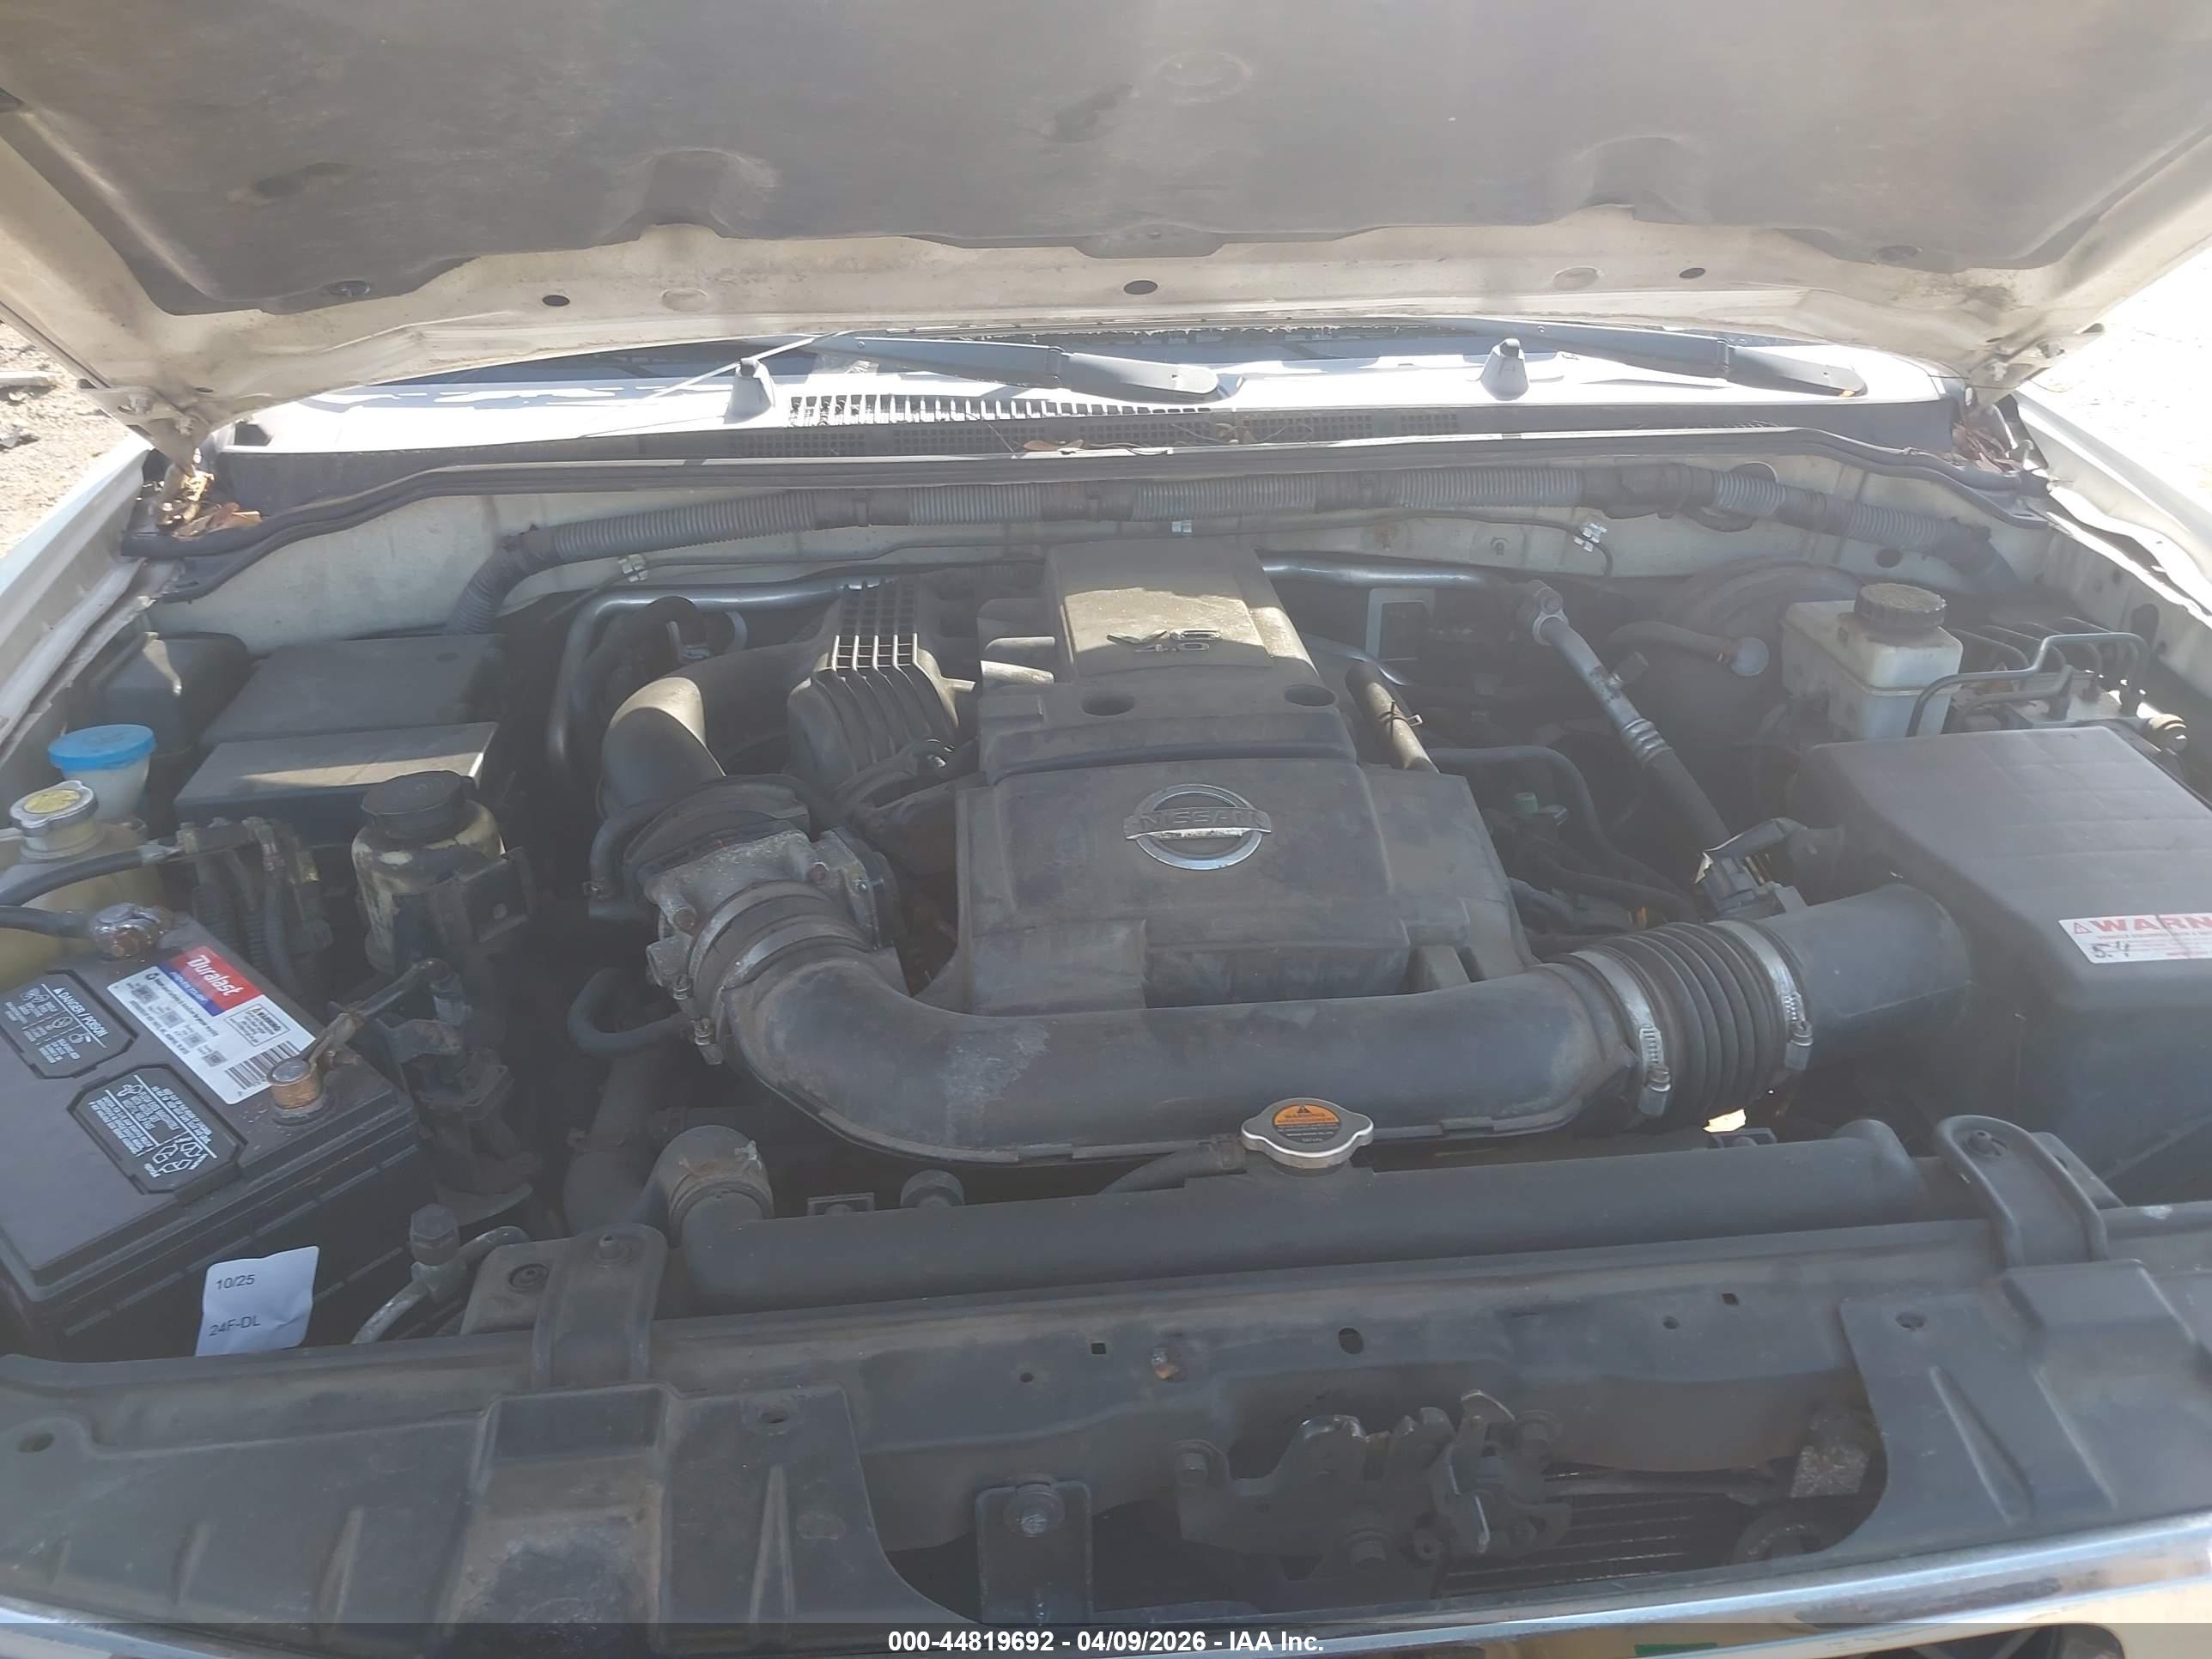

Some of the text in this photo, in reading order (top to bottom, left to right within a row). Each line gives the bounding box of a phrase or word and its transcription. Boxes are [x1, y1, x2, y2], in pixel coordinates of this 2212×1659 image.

[185, 954, 245, 997] Duralast
[216, 1274, 255, 1290] 10/25
[209, 1315, 262, 1337] 24F-DL
